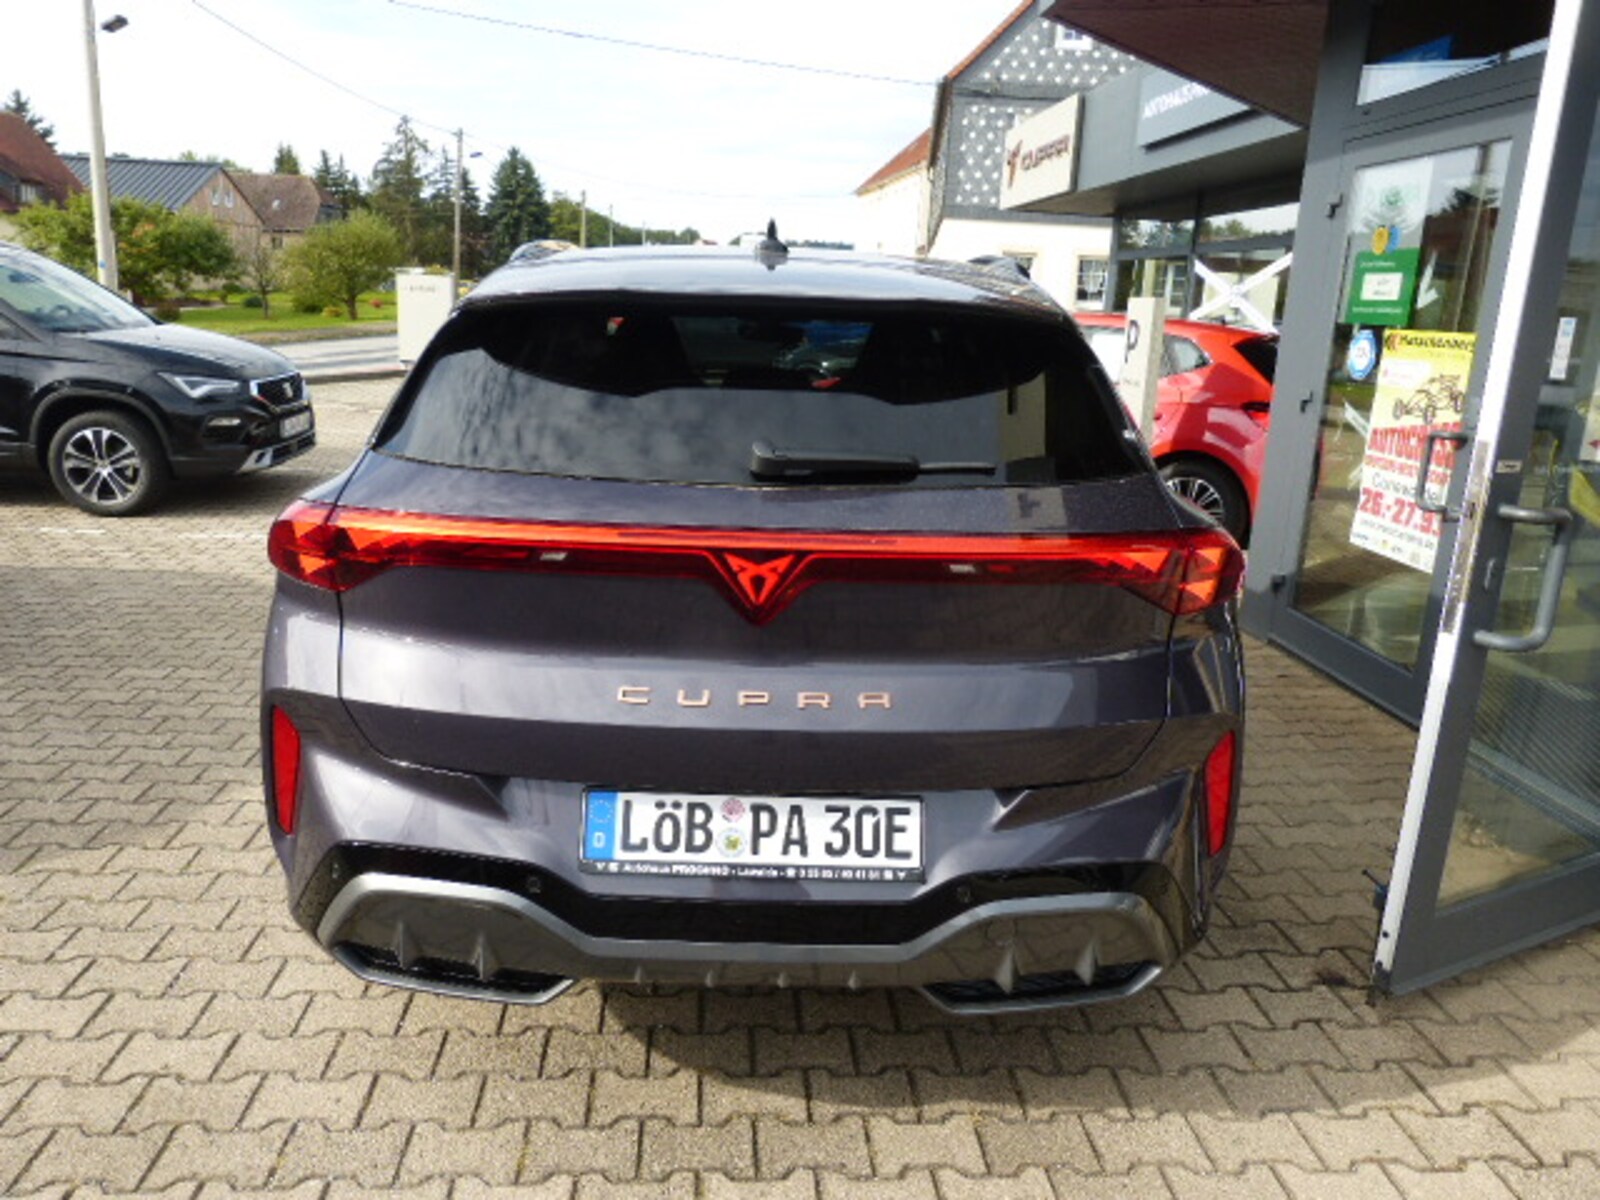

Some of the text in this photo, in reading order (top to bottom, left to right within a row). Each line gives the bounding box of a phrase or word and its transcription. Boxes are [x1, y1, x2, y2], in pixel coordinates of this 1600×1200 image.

[1125, 320, 1140, 363] P
[617, 685, 891, 709] CUPRA
[750, 803, 809, 857] PA
[824, 804, 912, 860] 30E
